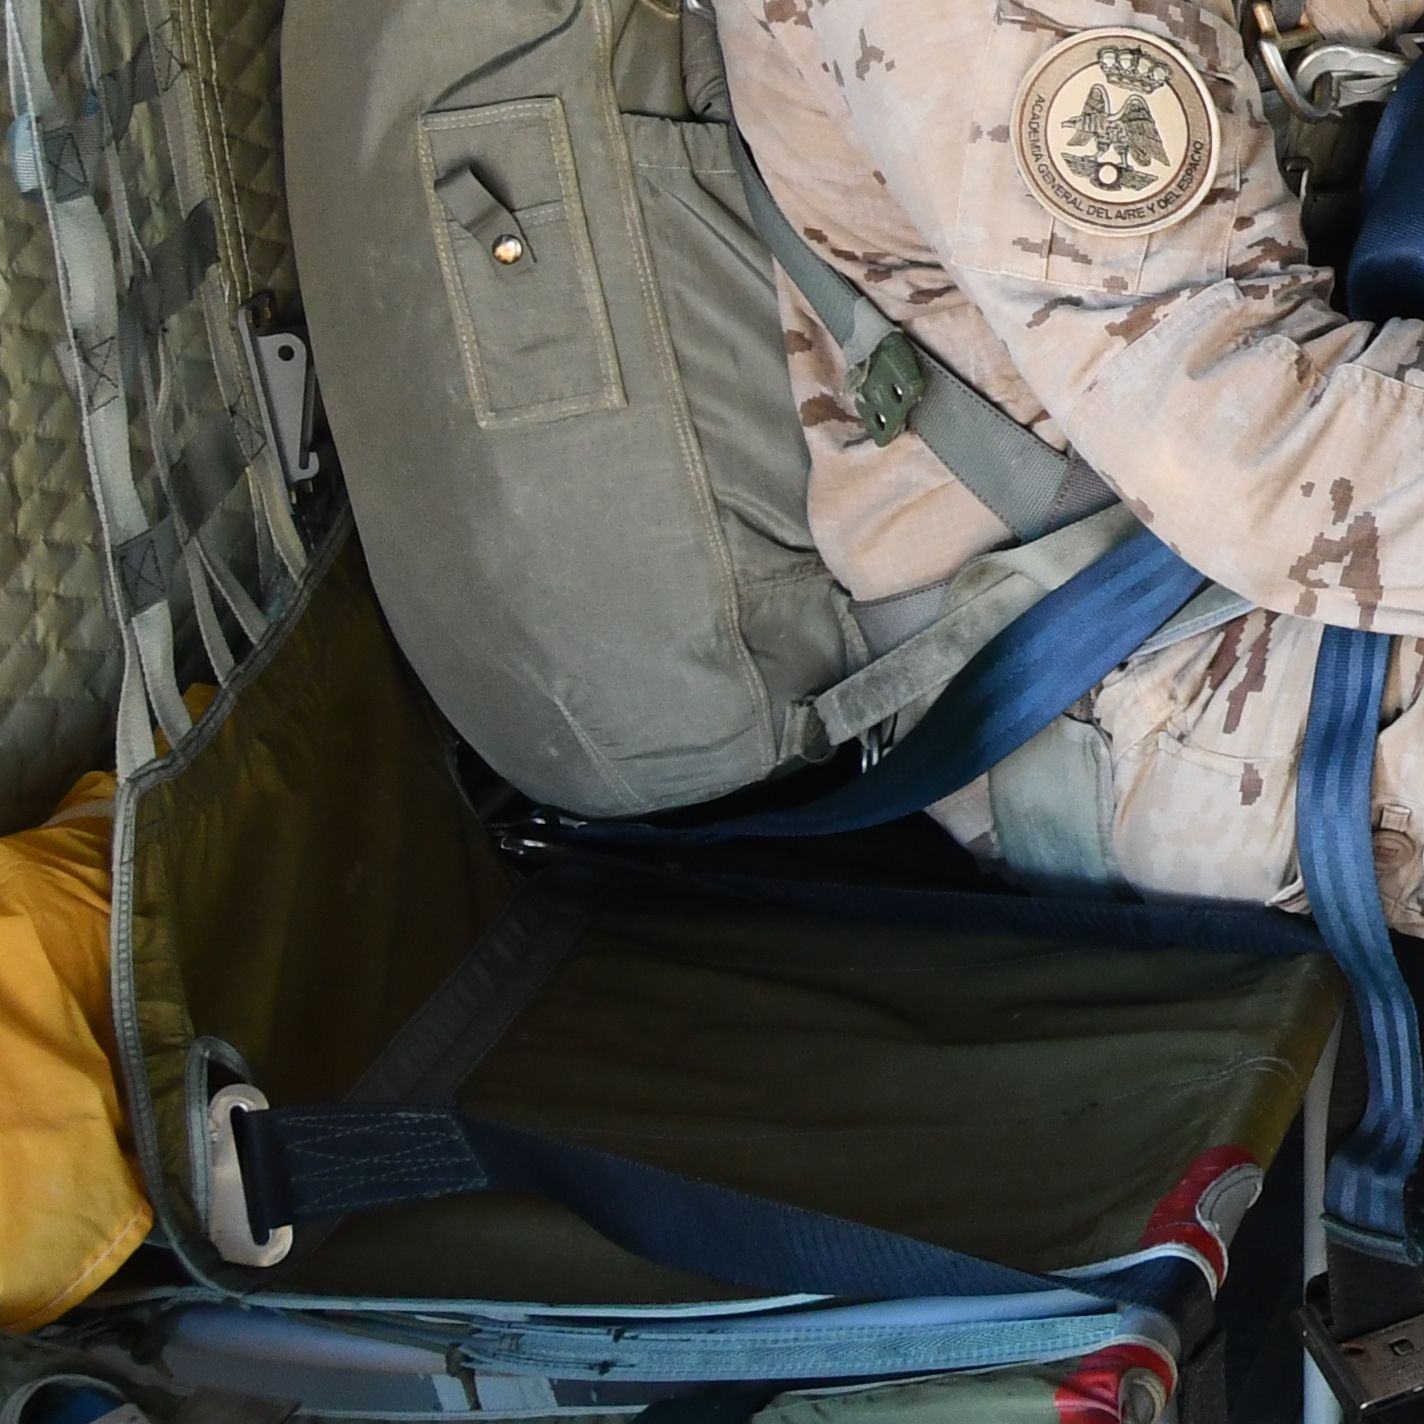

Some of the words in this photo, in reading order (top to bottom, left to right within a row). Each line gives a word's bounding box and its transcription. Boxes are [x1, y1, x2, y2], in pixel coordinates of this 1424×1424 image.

[1028, 93, 1046, 162] ACADEMIA
[1037, 163, 1083, 212] GENERAL
[1087, 204, 1113, 220] DEL
[1114, 208, 1146, 220] AIRE
[1146, 203, 1157, 215] Y
[1157, 190, 1181, 210] DEL
[1177, 140, 1205, 193] ESPACIO
